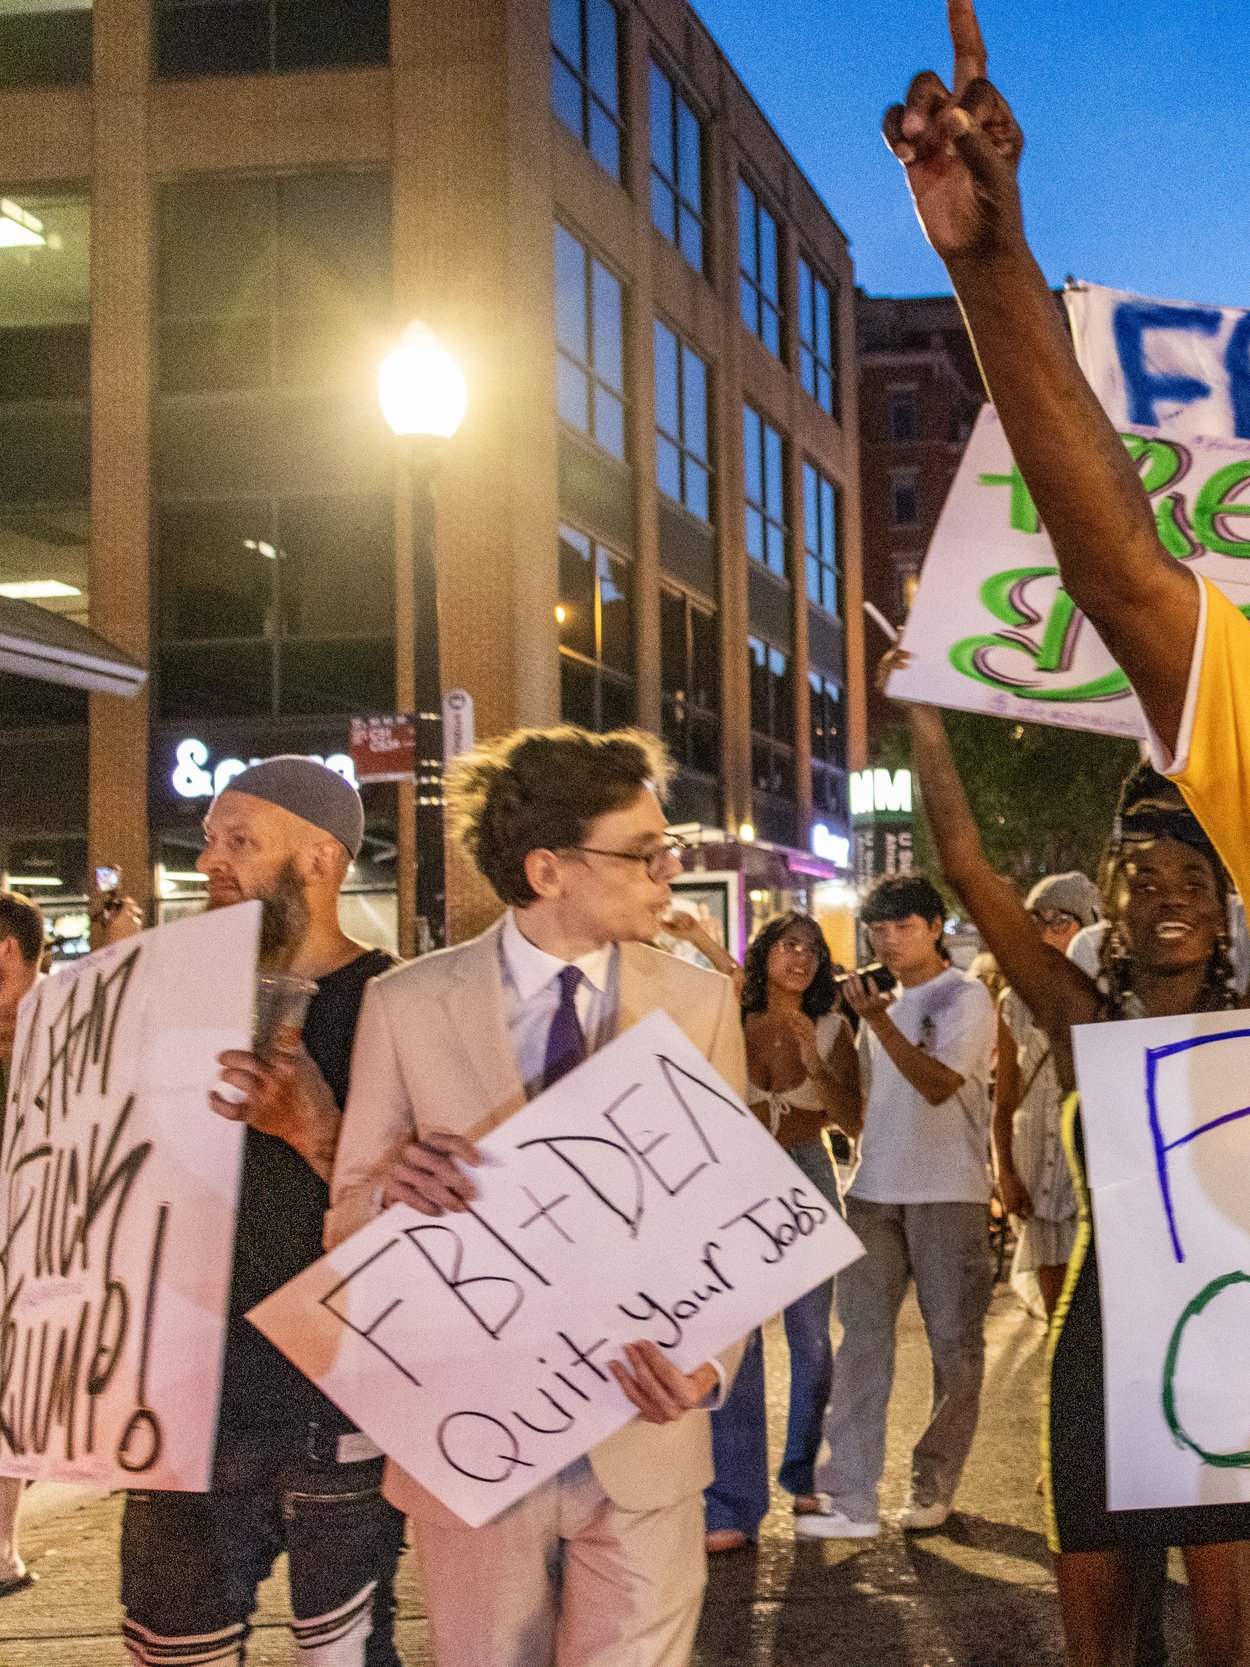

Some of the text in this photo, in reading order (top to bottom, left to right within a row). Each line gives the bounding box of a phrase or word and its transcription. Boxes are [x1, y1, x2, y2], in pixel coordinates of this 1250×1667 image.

[0, 1090, 152, 1285] FUCK
[437, 1331, 610, 1483] Quit
[718, 1187, 828, 1264] Jobs
